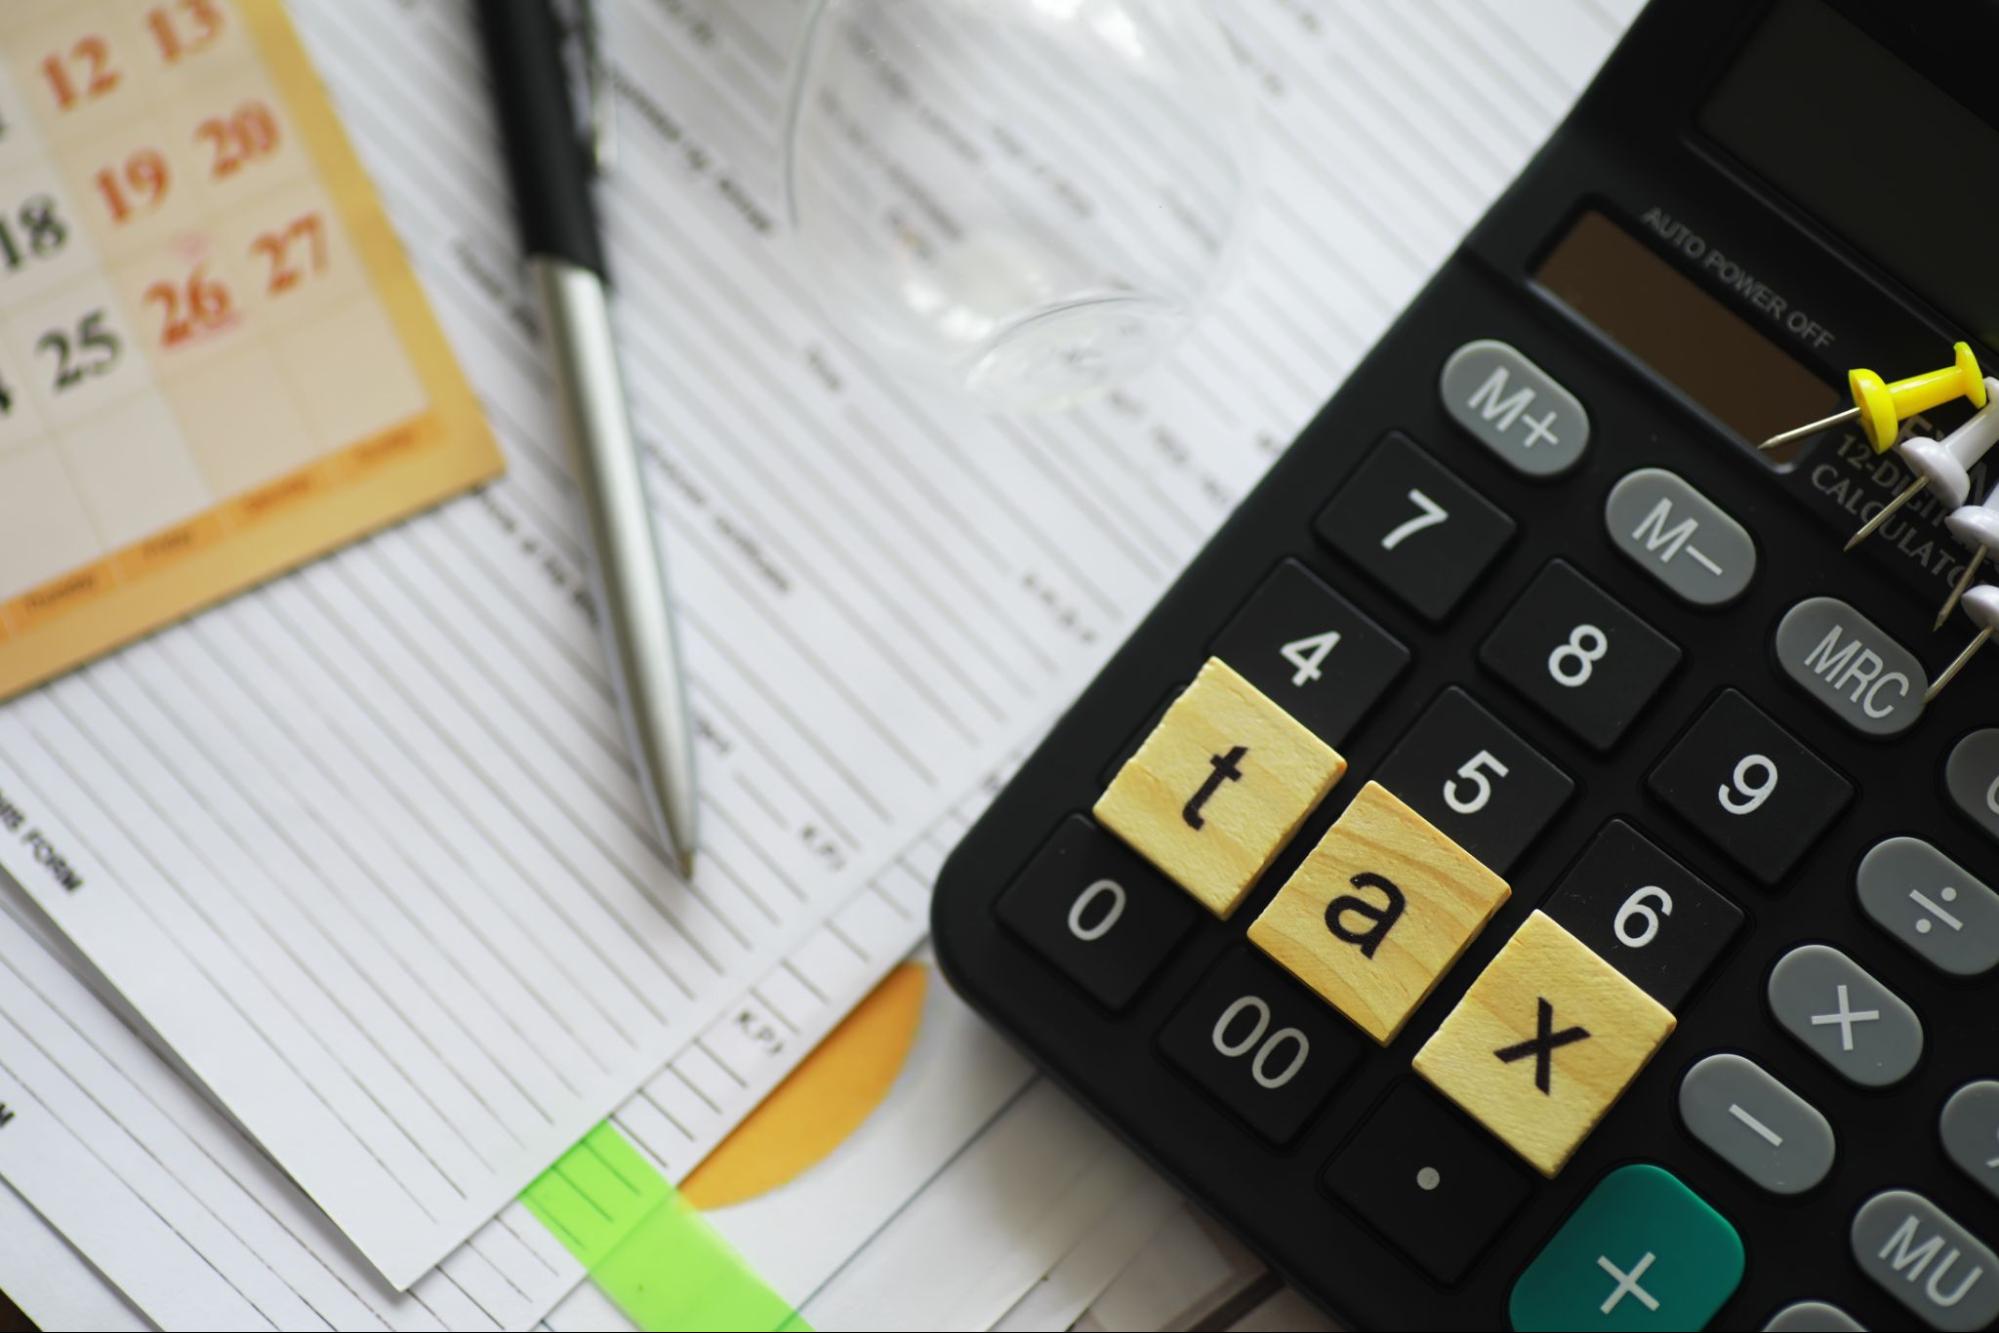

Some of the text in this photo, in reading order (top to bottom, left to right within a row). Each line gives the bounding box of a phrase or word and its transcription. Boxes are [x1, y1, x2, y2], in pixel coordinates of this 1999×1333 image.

[41, 34, 122, 112] 12
[95, 146, 171, 224] 19
[192, 99, 282, 181] 20
[35, 212, 329, 392] 25 26 27
[1641, 207, 1836, 348] AUTO POWER OFF
[1467, 366, 1559, 448] M+
[1381, 488, 1449, 550] 7
[1279, 630, 1341, 687] 4
[1548, 624, 1608, 687] 8
[1804, 625, 1910, 719] MRC
[1443, 750, 1509, 814] 5
[1718, 754, 1778, 815] 9
[1068, 879, 1126, 941] 0
[1613, 885, 1673, 948] 6
[1212, 996, 1310, 1089] 00
[1878, 1215, 1983, 1308] MU
